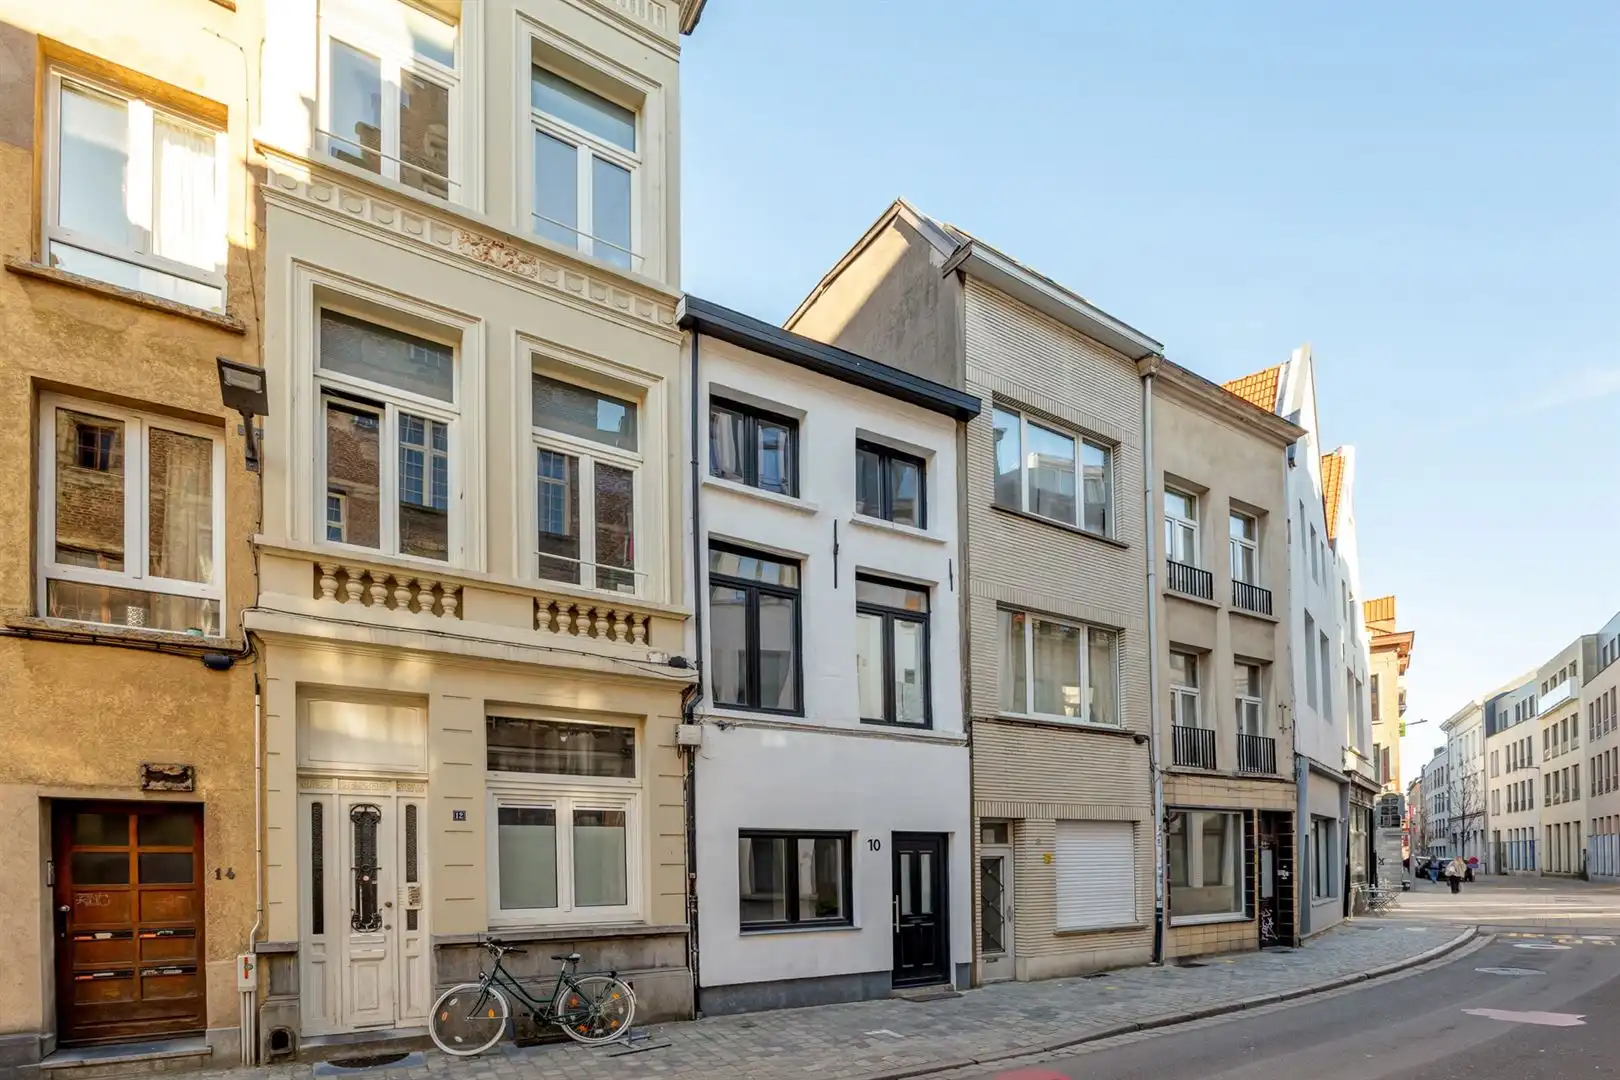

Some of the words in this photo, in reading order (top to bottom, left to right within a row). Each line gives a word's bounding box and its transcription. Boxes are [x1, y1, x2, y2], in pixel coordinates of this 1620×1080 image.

[454, 811, 465, 820] 12
[867, 839, 881, 851] 10
[215, 867, 236, 880] 14
